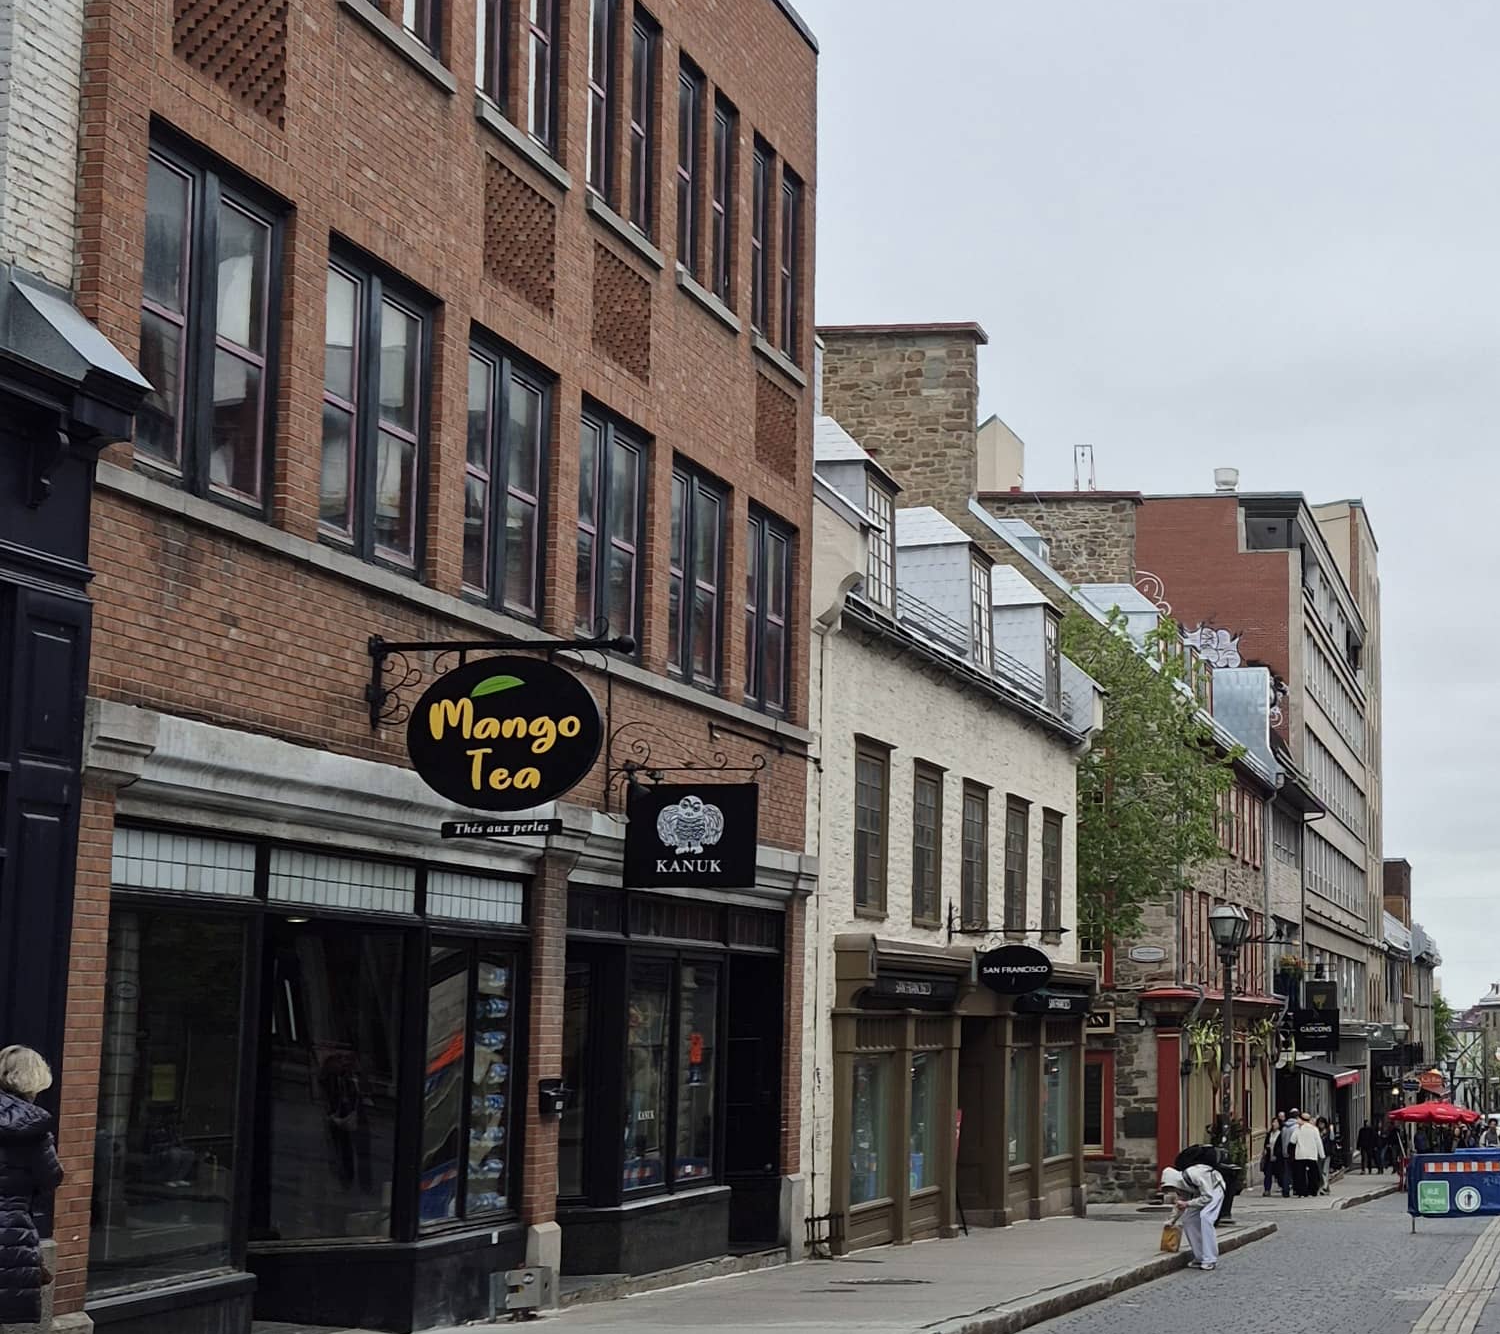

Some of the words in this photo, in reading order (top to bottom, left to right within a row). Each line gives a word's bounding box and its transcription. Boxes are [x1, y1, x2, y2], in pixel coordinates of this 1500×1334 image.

[429, 697, 581, 754] Mango
[466, 748, 541, 790] Tea
[454, 823, 483, 835] Thés
[486, 824, 509, 833] aux
[512, 822, 549, 835] perles
[656, 860, 722, 873] KANUK
[983, 966, 1000, 974] SAN
[1001, 965, 1048, 974] FRANCISCO
